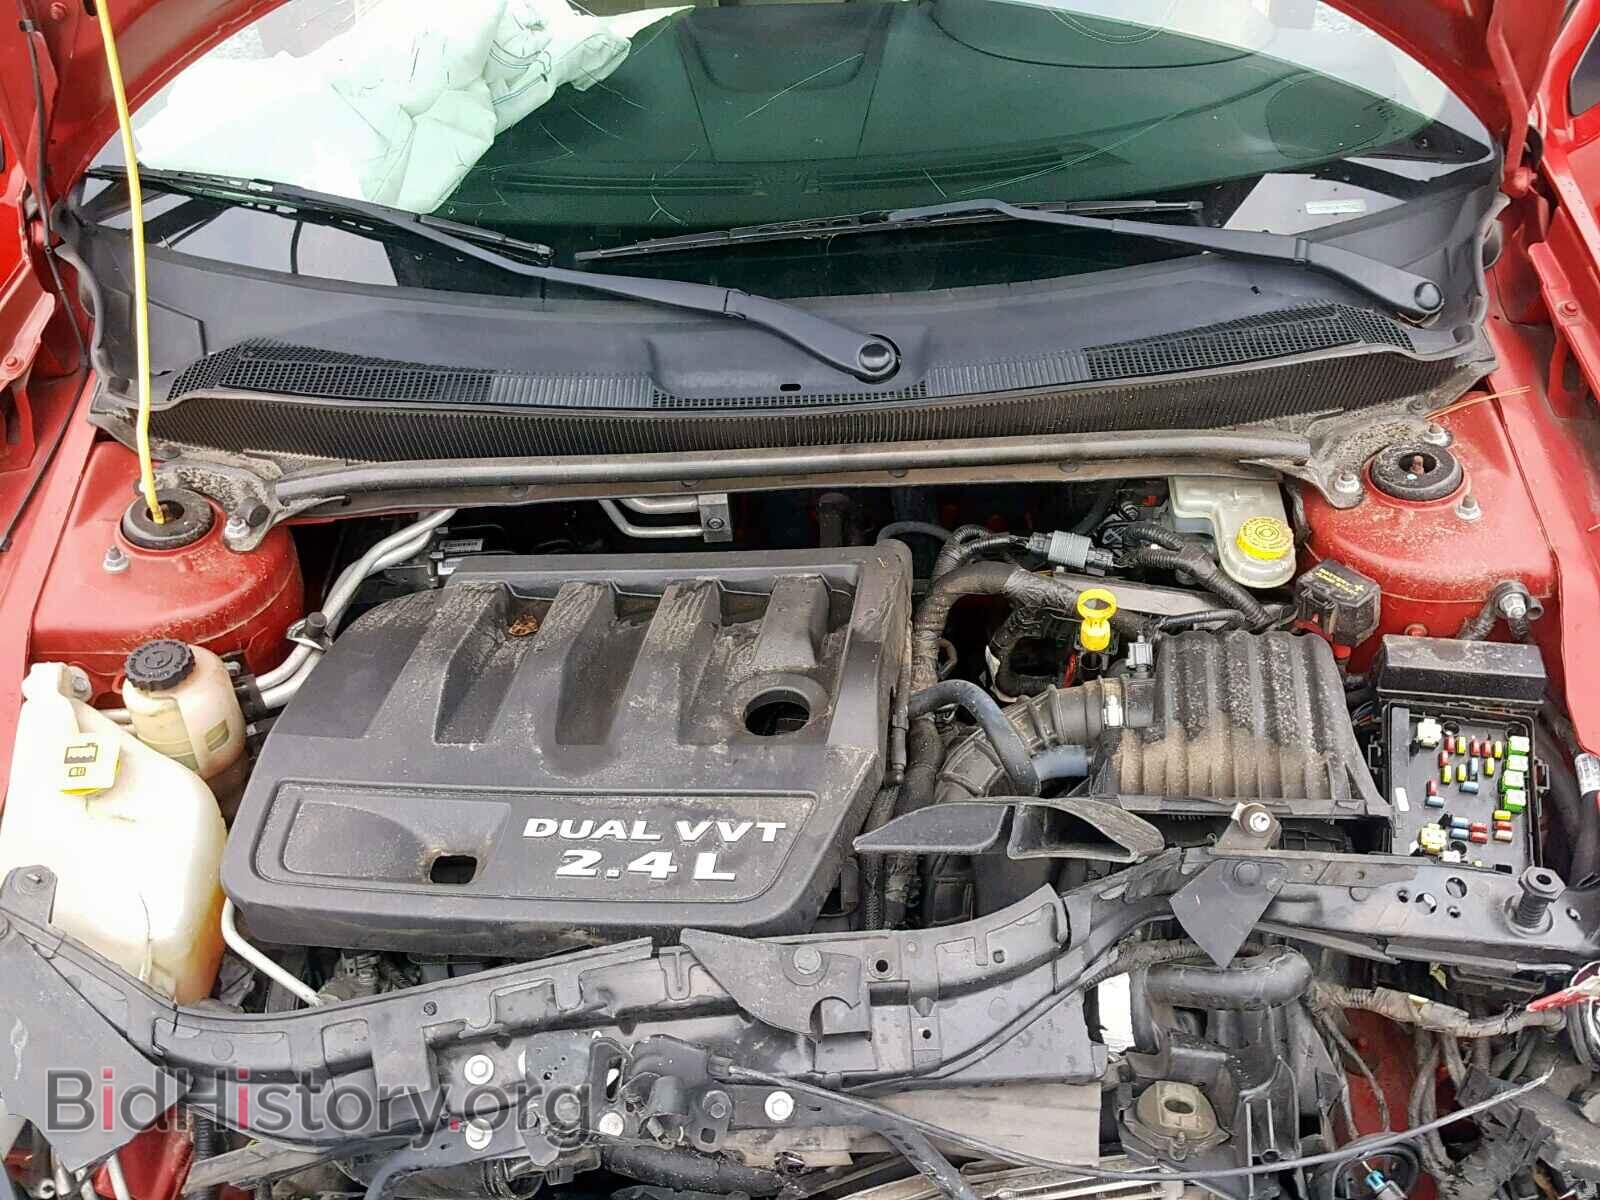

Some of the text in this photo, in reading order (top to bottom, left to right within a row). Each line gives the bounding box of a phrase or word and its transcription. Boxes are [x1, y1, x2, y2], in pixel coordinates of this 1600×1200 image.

[522, 817, 787, 843] DUAL VVT
[555, 849, 737, 881] 2.4 L
